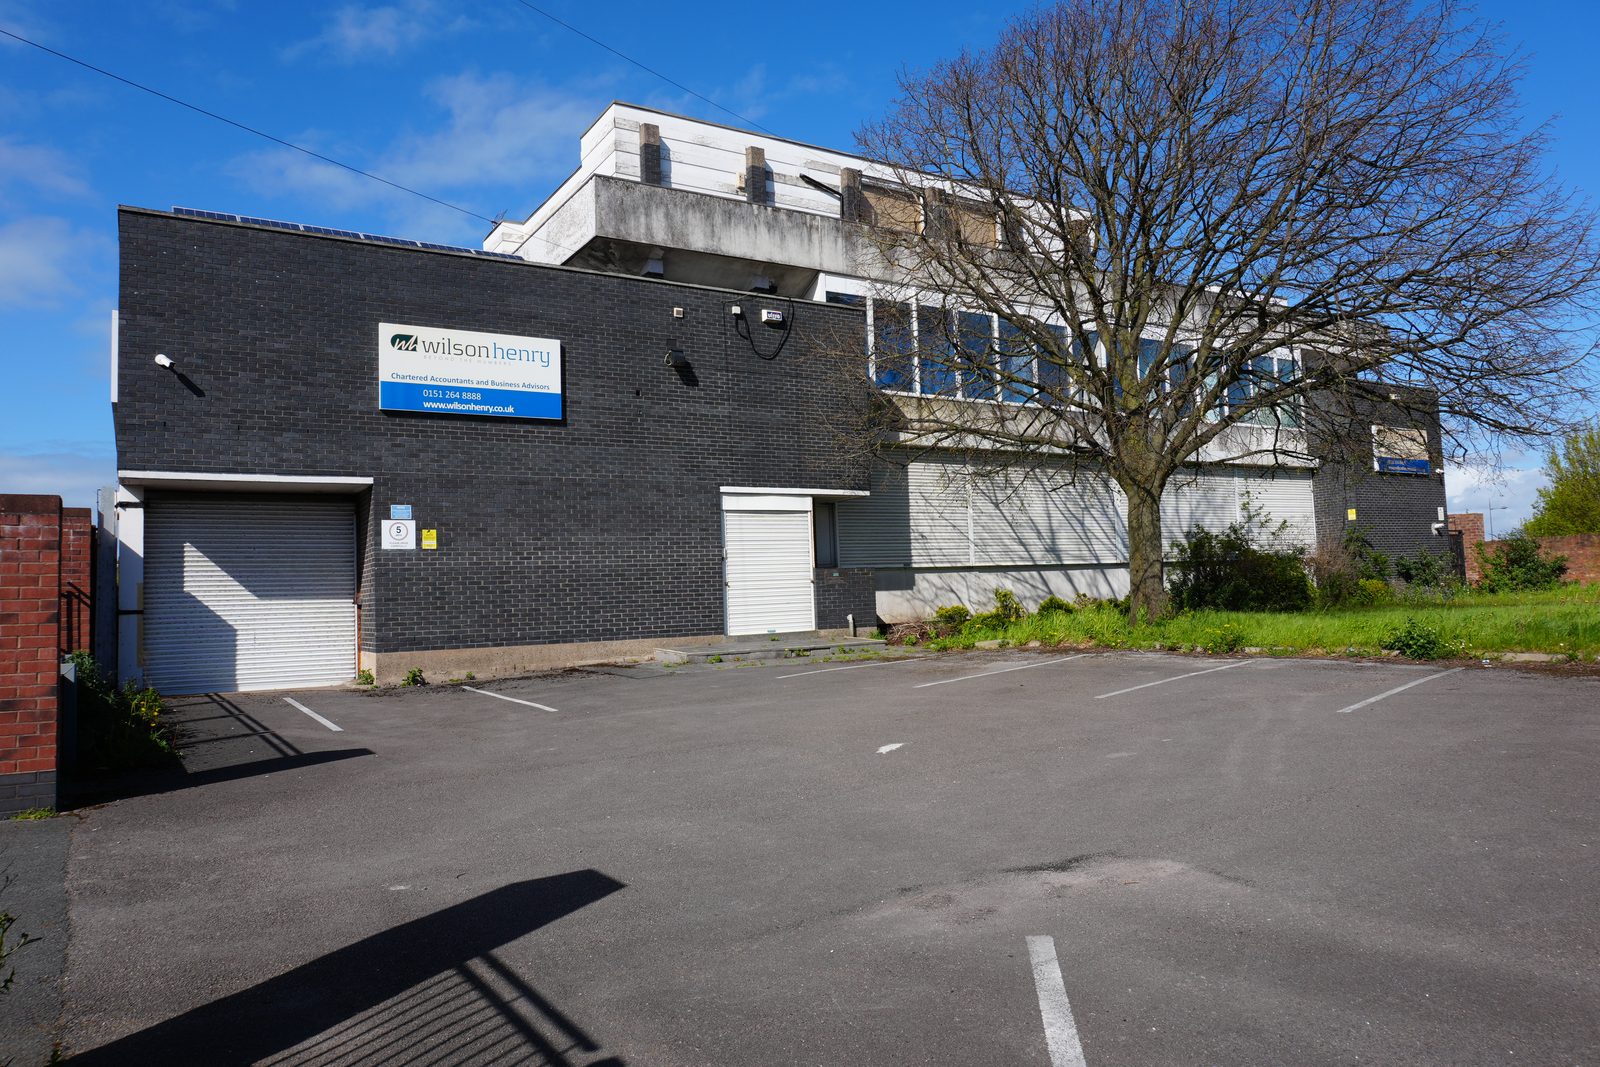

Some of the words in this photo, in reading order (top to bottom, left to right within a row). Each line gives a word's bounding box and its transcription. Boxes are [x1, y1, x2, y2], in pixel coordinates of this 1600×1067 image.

[391, 372, 428, 381] Chartered
[430, 375, 474, 384] Accountants
[491, 380, 520, 388] Business
[522, 382, 550, 390] Advisors
[423, 389, 443, 397] 0151
[462, 392, 481, 400] 8888
[423, 401, 514, 413] www.wilsonhenry.co.uk
